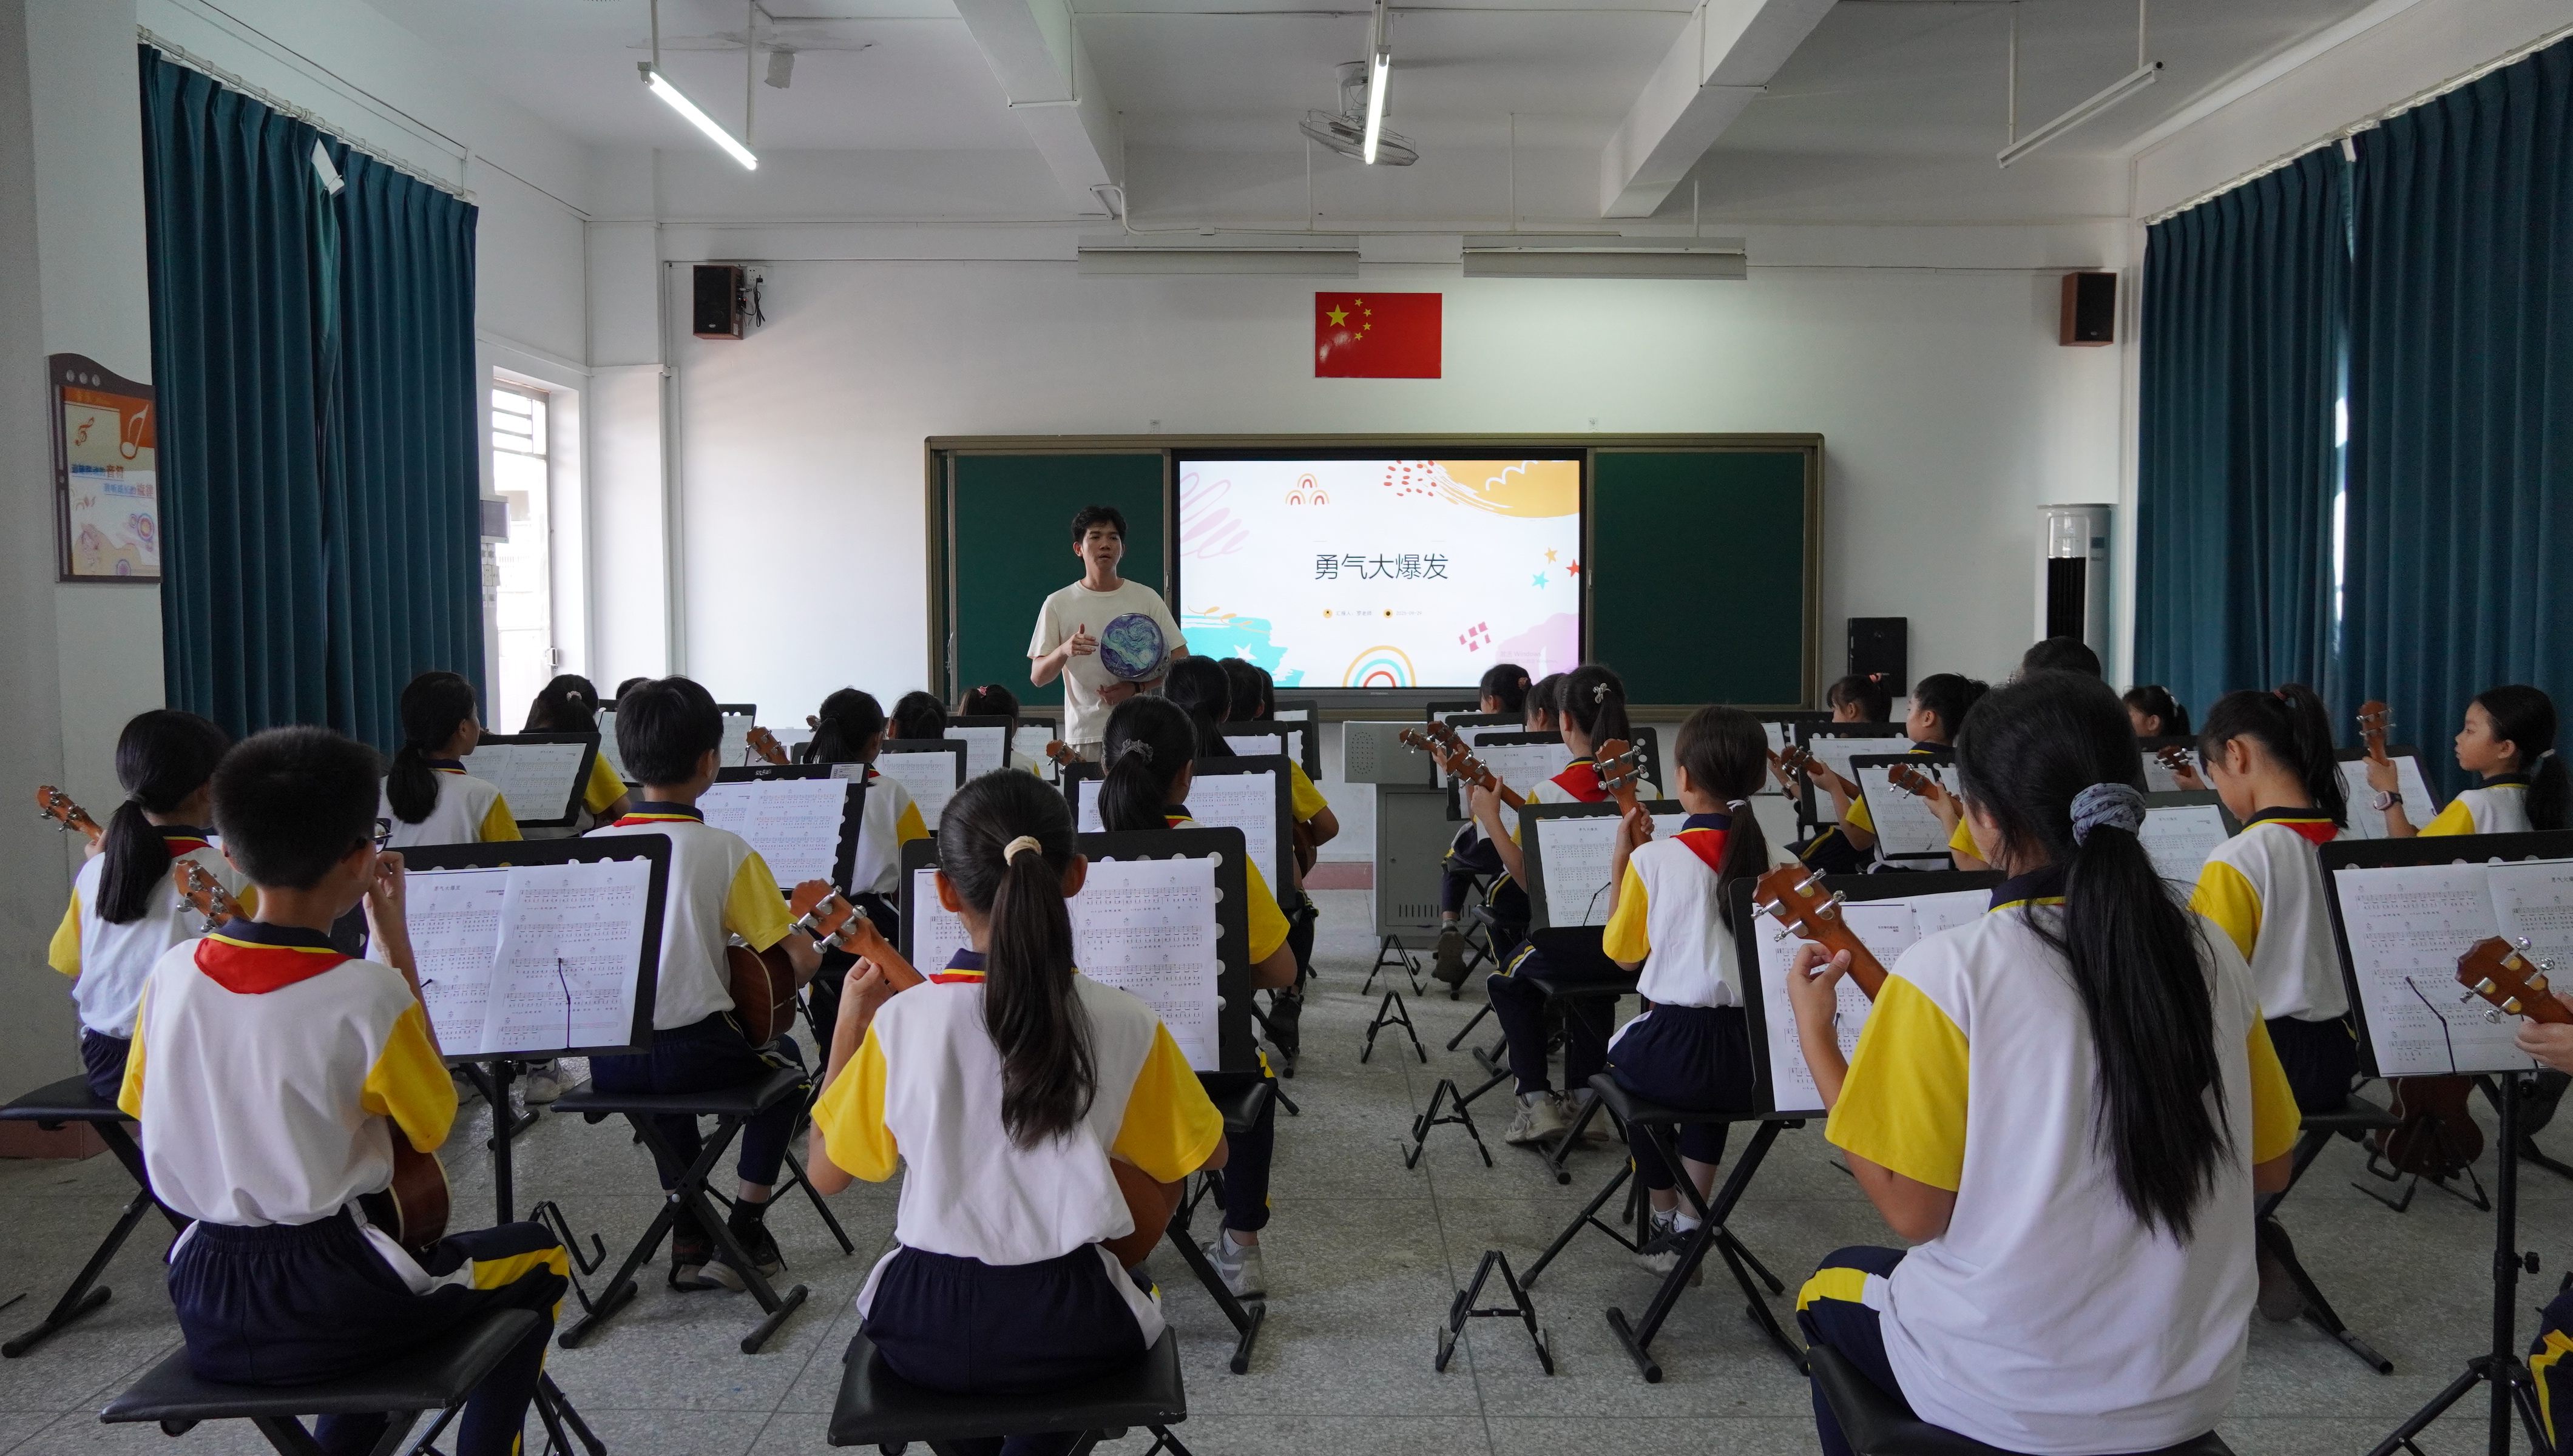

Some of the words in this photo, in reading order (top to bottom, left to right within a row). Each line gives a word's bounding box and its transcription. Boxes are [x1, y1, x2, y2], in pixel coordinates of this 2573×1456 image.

[1314, 553, 1449, 580] 勇气大爆发
